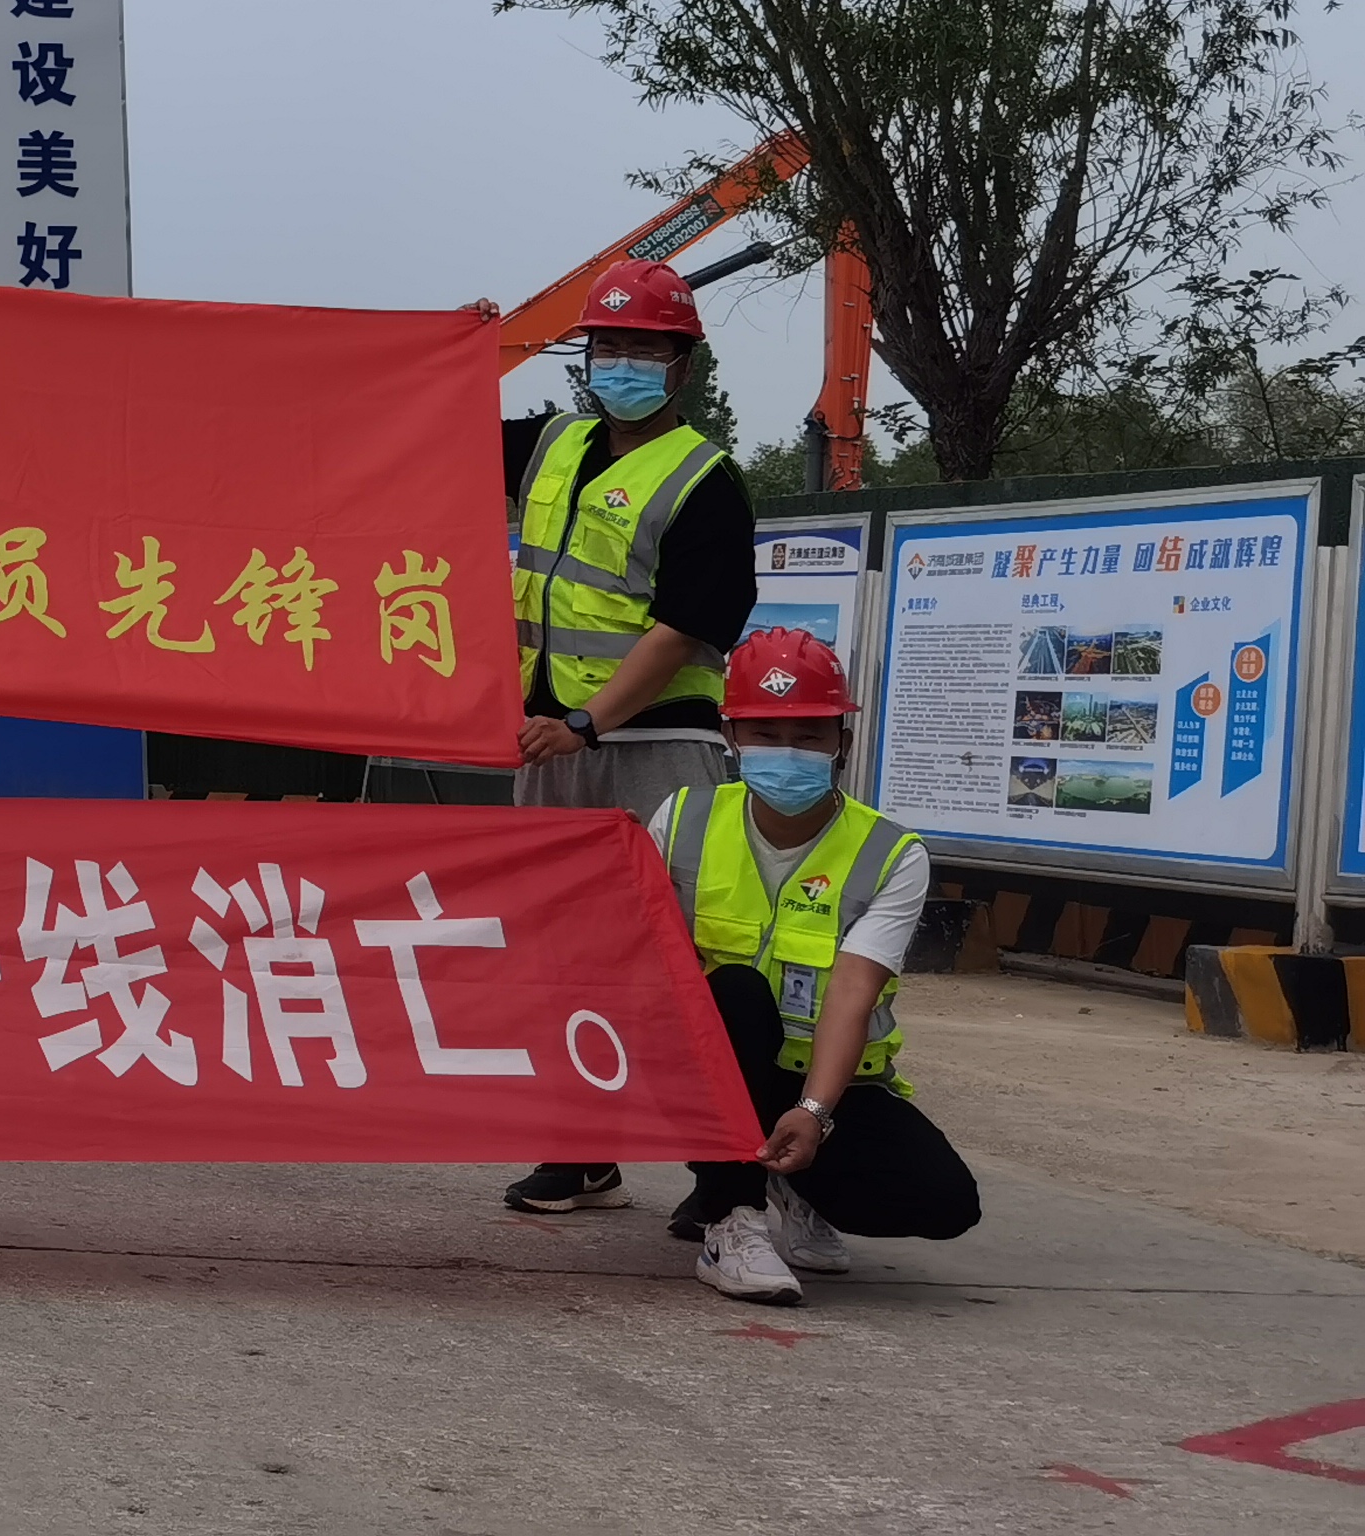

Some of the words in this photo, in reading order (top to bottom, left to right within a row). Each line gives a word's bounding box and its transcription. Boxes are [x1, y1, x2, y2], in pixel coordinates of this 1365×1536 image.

[991, 543, 1122, 579] 凝聚产生力量
[1132, 534, 1283, 573] 团结成就辉煌
[1189, 595, 1232, 612] 企业文化
